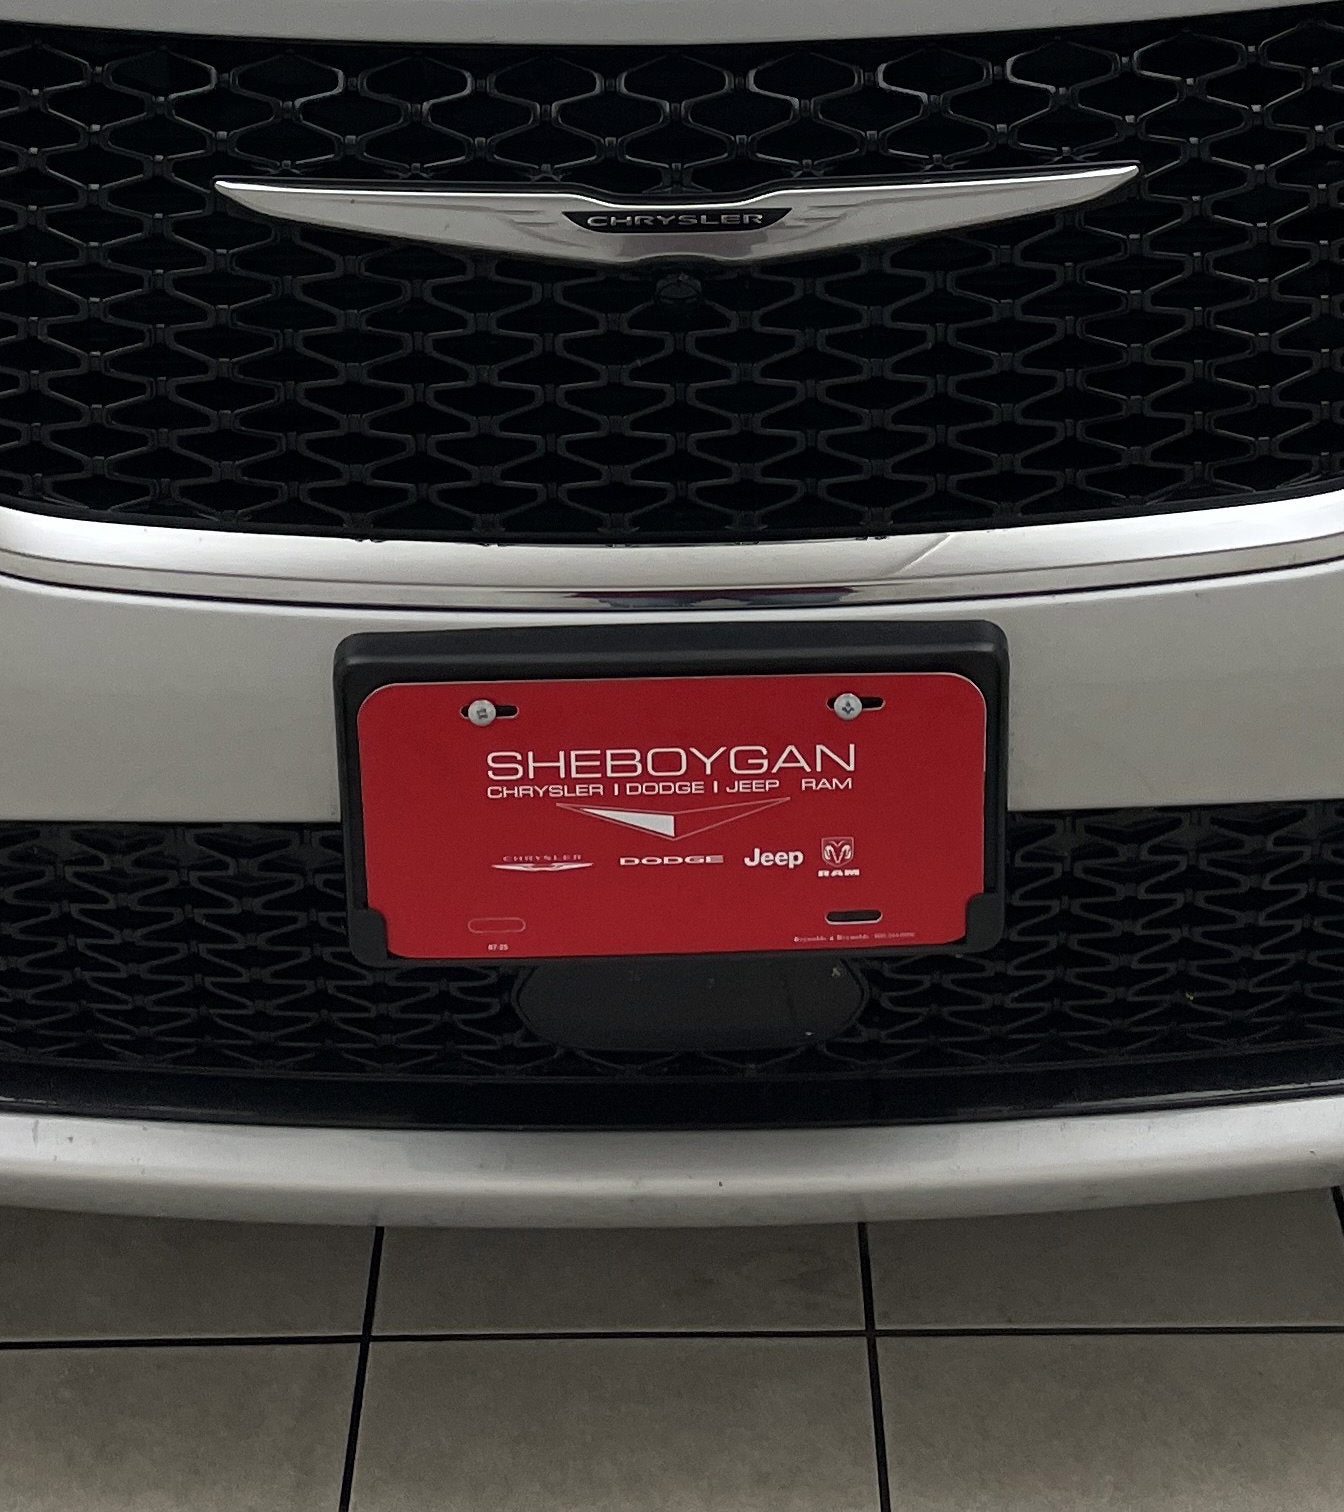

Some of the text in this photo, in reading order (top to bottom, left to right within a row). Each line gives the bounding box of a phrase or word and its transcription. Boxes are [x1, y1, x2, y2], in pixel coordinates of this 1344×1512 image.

[587, 214, 763, 227] CHRYSLER
[487, 743, 856, 781] SHEBOYGAN
[487, 783, 604, 799] CHRYSLER
[626, 781, 705, 796] DODGE
[726, 779, 780, 793] JEEP
[801, 778, 853, 791] RAM
[619, 855, 724, 866] DODGE
[743, 847, 805, 869] Jeep
[817, 869, 861, 877] RAM
